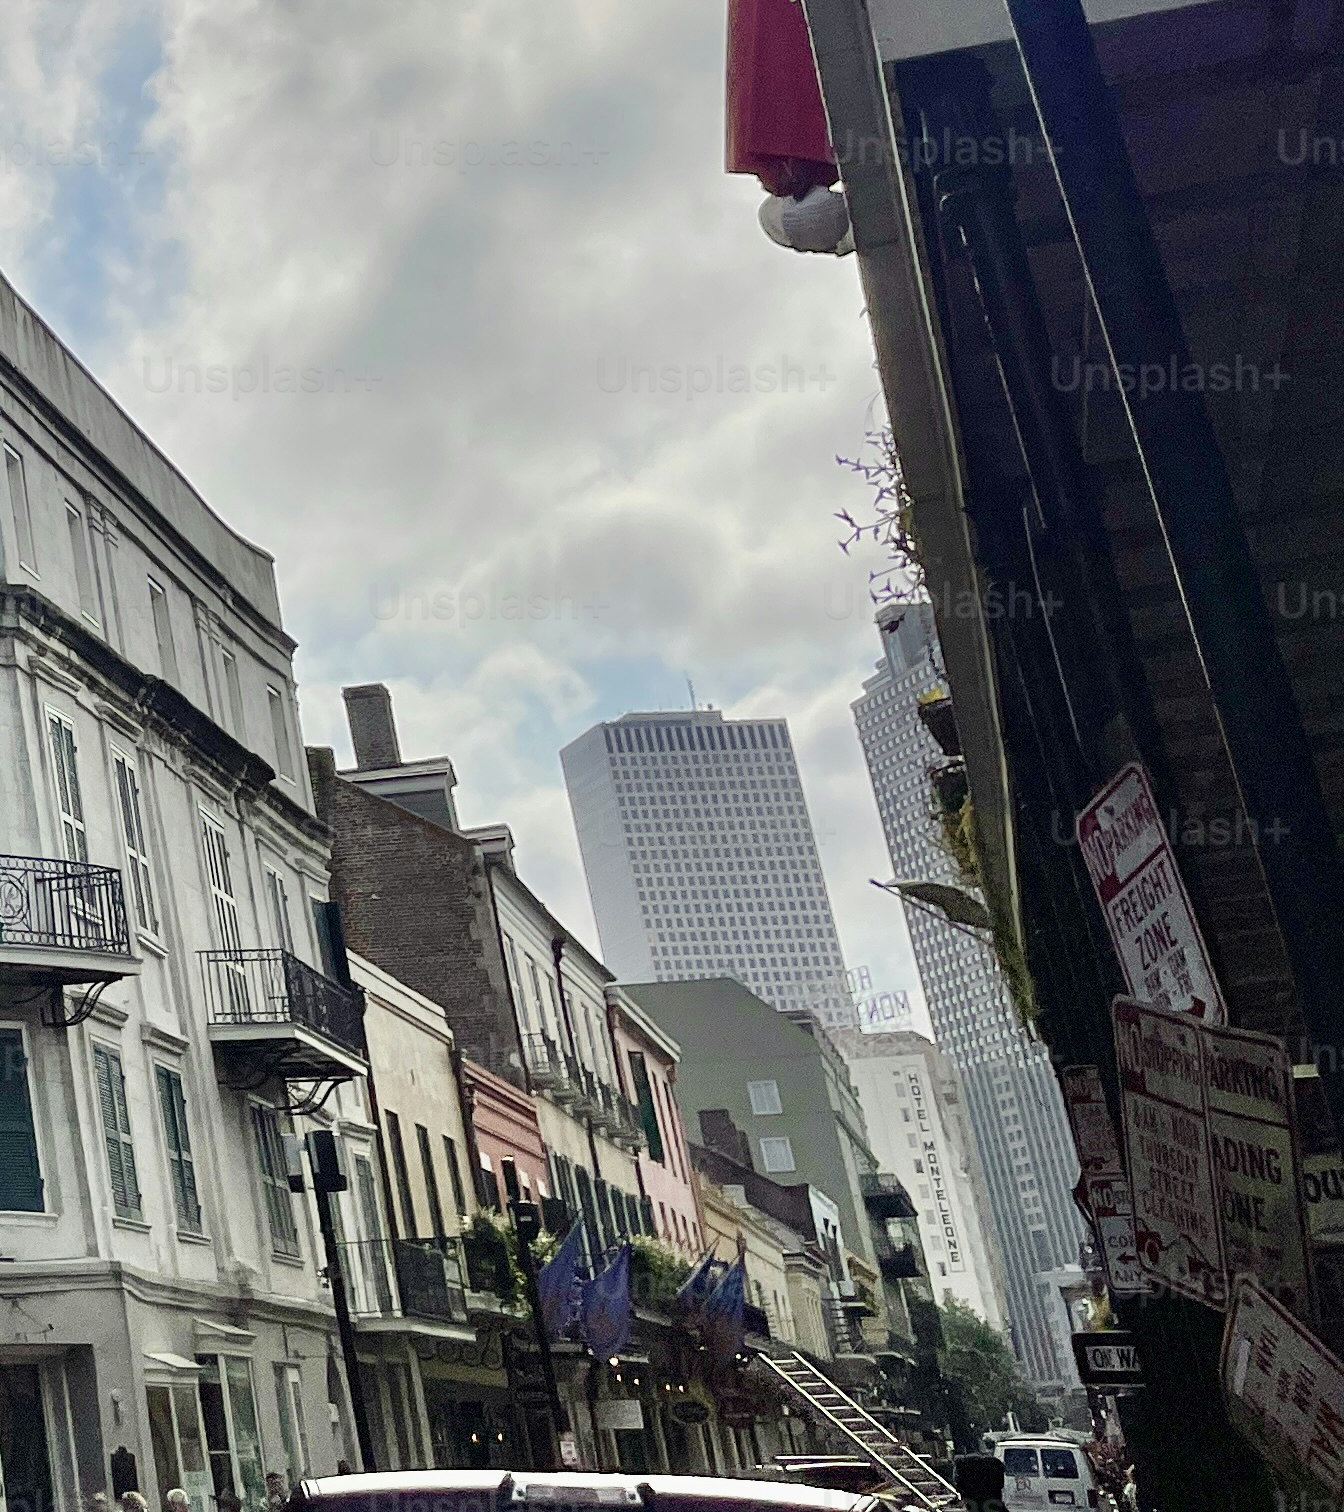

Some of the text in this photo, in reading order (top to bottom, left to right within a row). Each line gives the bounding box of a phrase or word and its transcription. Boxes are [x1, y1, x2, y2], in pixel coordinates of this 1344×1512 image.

[1082, 794, 1155, 886] NO PARKING
[1112, 860, 1173, 939] FREIGHT
[1134, 912, 1178, 972] ZONE
[908, 1074, 930, 1132] HOTEL
[1211, 1054, 1281, 1102] ARKING
[1211, 1134, 1282, 1185] ADING
[923, 1141, 960, 1262] MONTELEONE
[1091, 1188, 1114, 1209] NO
[1116, 1349, 1141, 1368] WA
